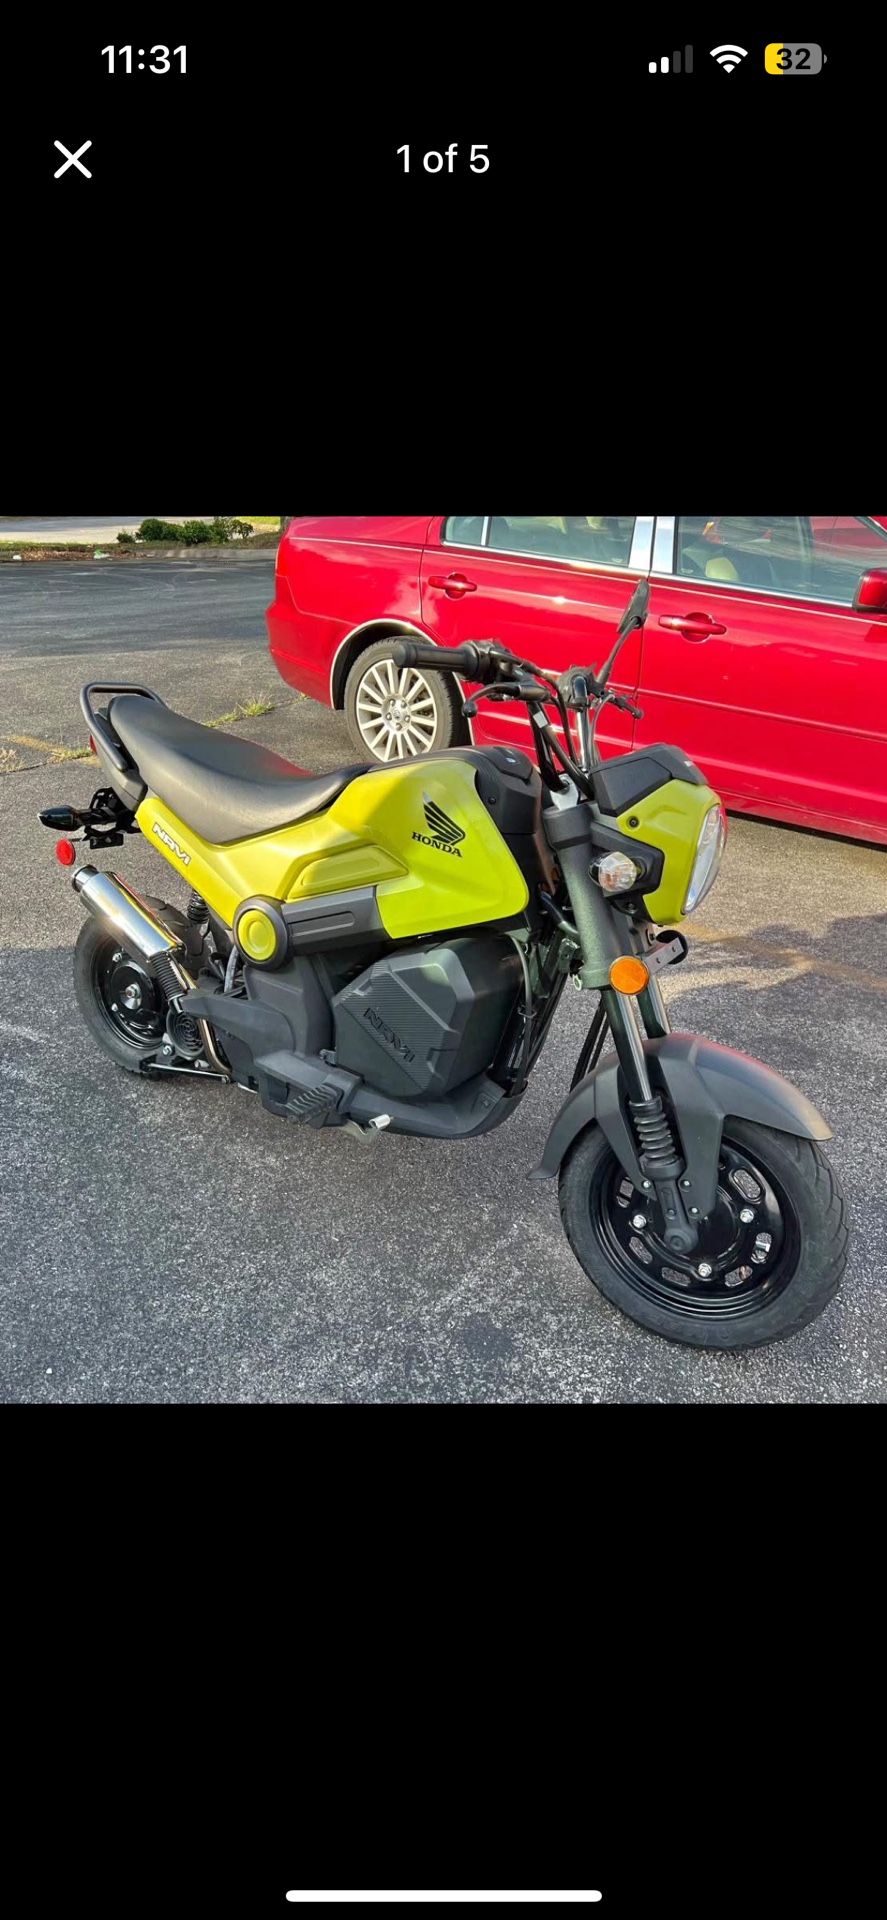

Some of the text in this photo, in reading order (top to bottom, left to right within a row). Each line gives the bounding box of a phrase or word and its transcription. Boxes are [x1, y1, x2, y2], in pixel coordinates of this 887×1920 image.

[152, 822, 191, 865] NAVI
[411, 832, 462, 857] HONDA
[363, 1007, 415, 1062] NAVI
